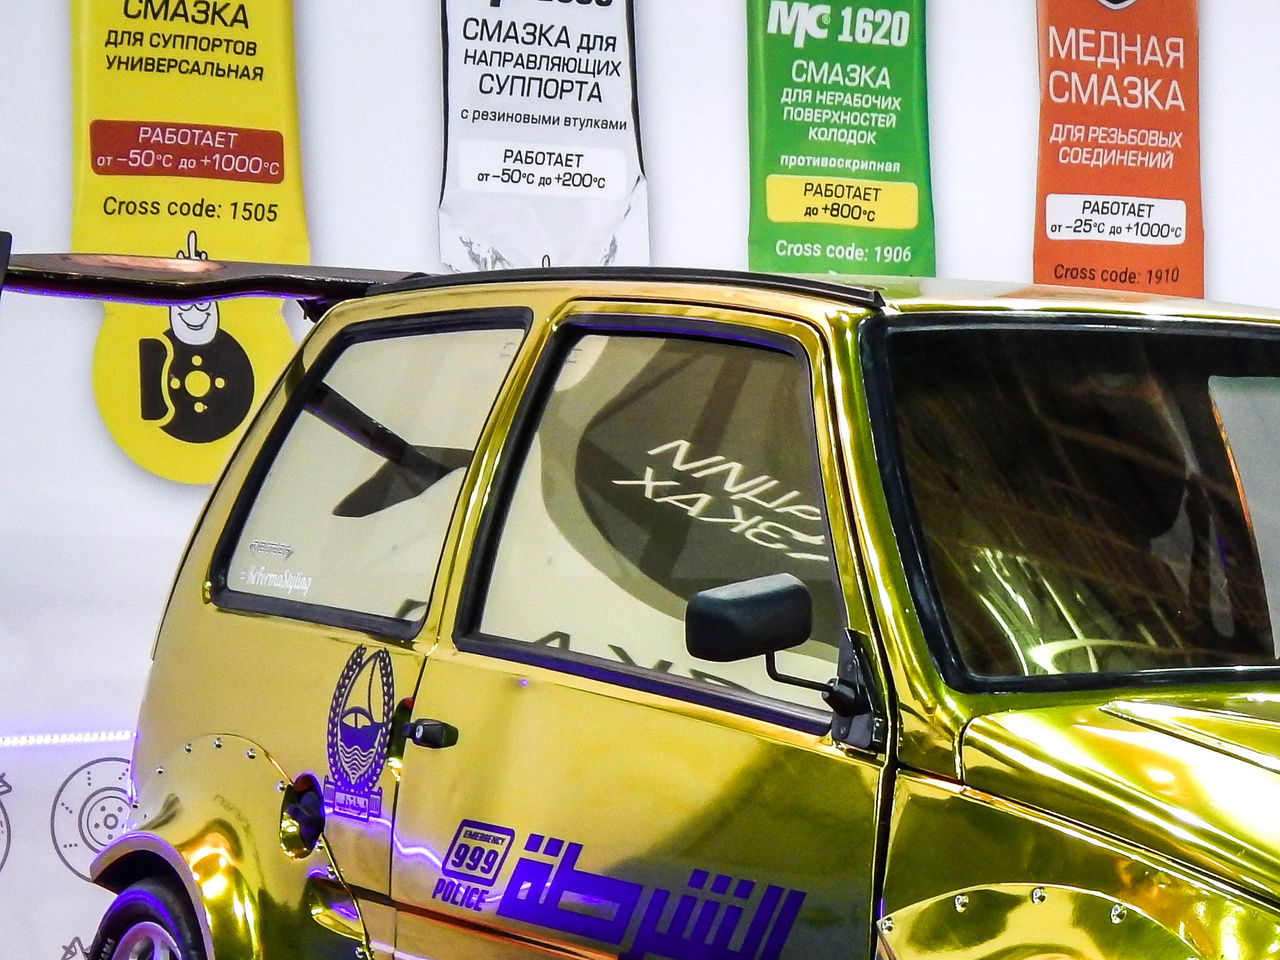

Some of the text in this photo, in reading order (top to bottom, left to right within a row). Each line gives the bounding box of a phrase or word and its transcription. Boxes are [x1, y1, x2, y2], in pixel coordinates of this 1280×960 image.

[123, 0, 249, 29] СМАЗКА
[837, 6, 910, 47] 1620
[105, 30, 257, 56] ДЛЯ СУППОРТОВ
[462, 17, 571, 49] СМАЗКА
[1049, 26, 1184, 70] МЕДНАЯ
[105, 55, 264, 81] УНИВЕРСАЛЬНАЯ
[464, 49, 622, 78] НАПРАВЛЯЮЩИХ
[791, 59, 891, 90] СМАЗКА
[479, 73, 603, 103] СУППОРТА
[781, 87, 901, 111] ДЛЯ НЕРАБОЧИХ
[1049, 70, 1186, 112] СМАЗКА
[472, 109, 560, 126] резиновыми
[563, 116, 627, 131] втулками
[783, 106, 896, 128] ПОВЕРХНОСТЕЙ
[138, 127, 238, 149] РАБОТАЕТ
[808, 126, 876, 145] КОЛОДОК
[1049, 123, 1183, 148] ДЛЯ РЕЗЬБОВЫХ
[97, 155, 113, 166] от
[178, 158, 196, 171] до
[503, 149, 584, 168] РАБОТАЕТ
[780, 154, 901, 173] противоскрипная
[1058, 146, 1174, 169] СОЕДИНЕНИЙ
[477, 172, 490, 182] от
[538, 175, 552, 187] до
[803, 182, 881, 202] РАБОТАЕТ
[103, 196, 278, 222] Cross code: 1505
[804, 206, 818, 218] до
[1081, 200, 1154, 219] РАБОТАЕТ
[1050, 223, 1062, 233] от
[1109, 225, 1122, 236] до
[775, 239, 912, 263] Cross code: 1906
[1054, 263, 1180, 285] Cross code: 1910
[451, 843, 499, 875] 999
[431, 877, 490, 913] POLICE
